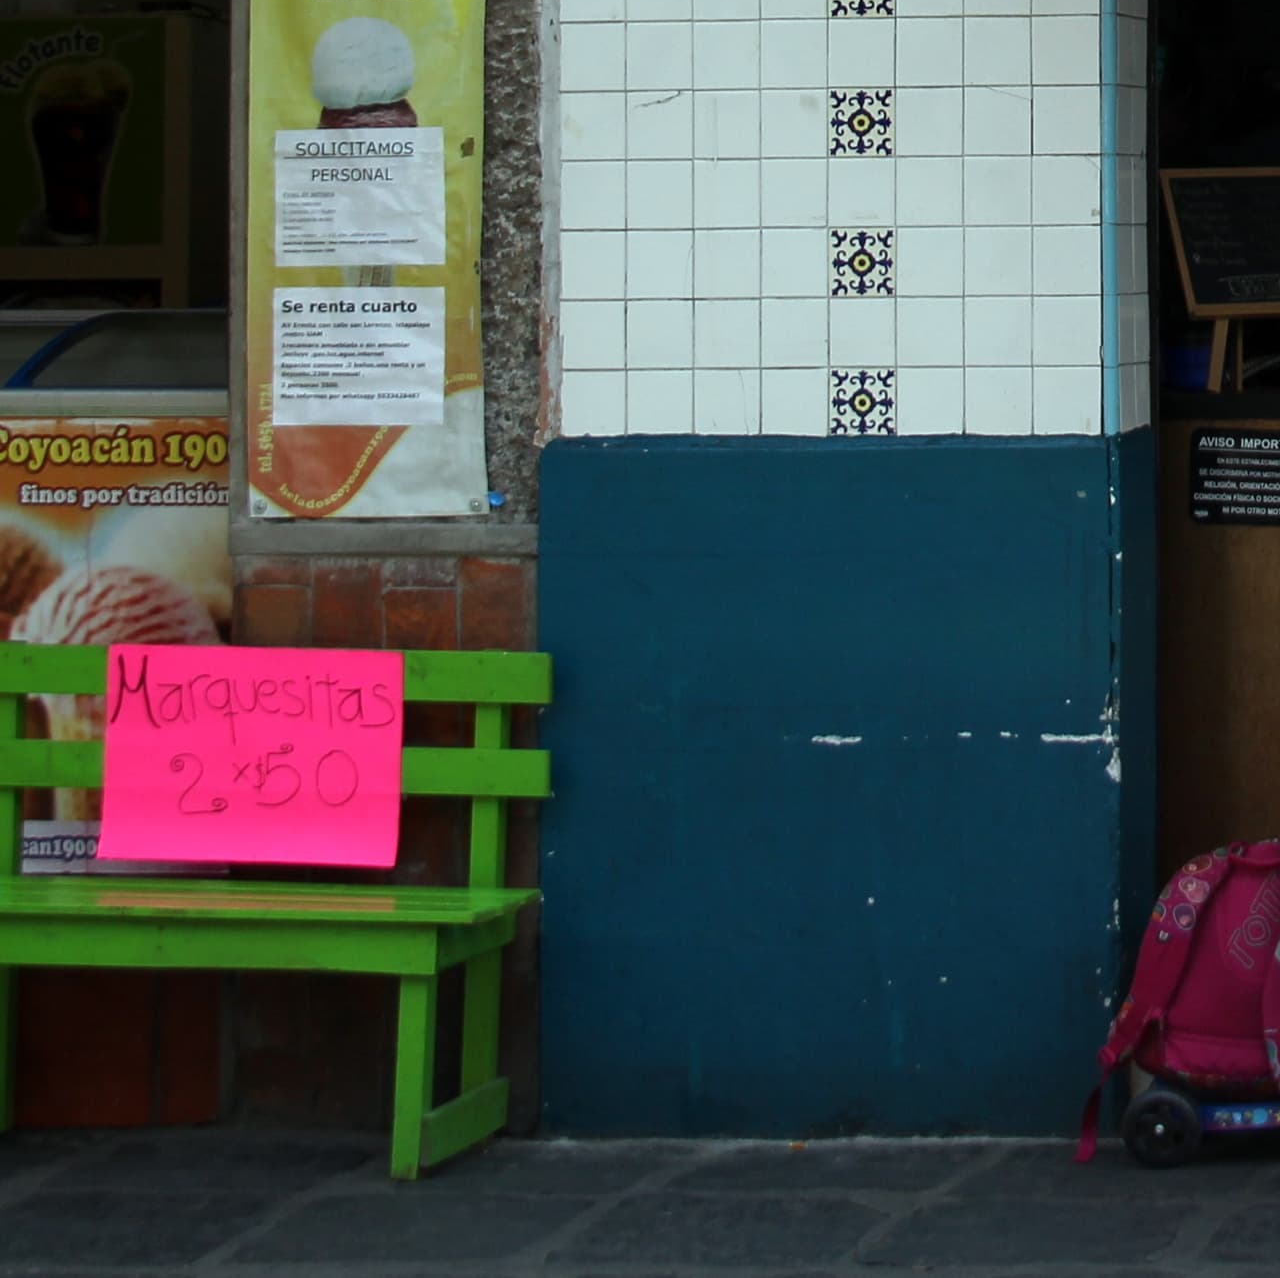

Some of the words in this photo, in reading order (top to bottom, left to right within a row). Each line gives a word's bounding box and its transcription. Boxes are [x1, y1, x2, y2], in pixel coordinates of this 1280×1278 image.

[295, 141, 415, 157] SOLICITAMOS
[311, 168, 393, 183] PERSONAL
[281, 300, 303, 313] Se
[310, 300, 355, 313] renta
[361, 300, 418, 313] cuarto
[1199, 436, 1235, 448] AVISO
[163, 432, 229, 469] 190
[20, 484, 78, 504] finos
[81, 488, 123, 508] por
[127, 484, 230, 504] tradición
[111, 654, 400, 746] Marquesitas
